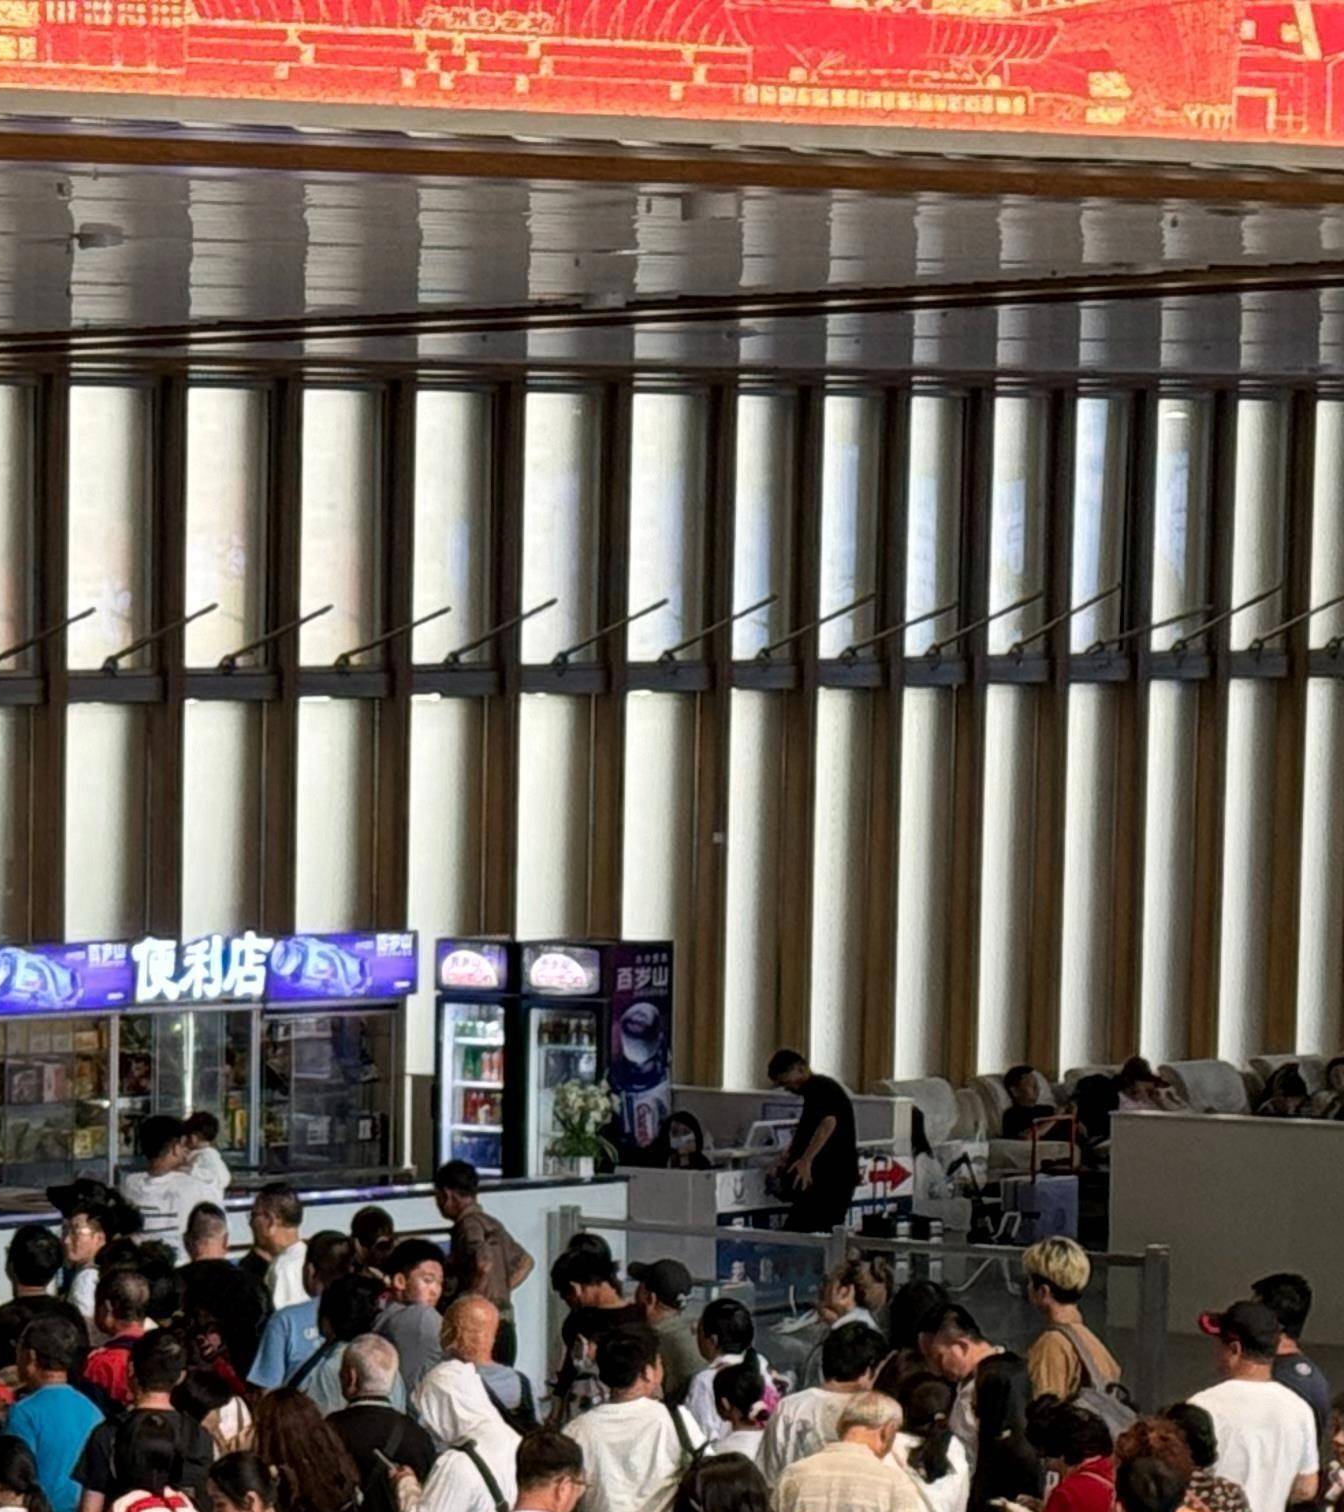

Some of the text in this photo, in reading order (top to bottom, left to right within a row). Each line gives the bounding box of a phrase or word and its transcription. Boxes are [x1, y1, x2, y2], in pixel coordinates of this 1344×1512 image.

[132, 931, 274, 1003] 便利店
[617, 965, 668, 991] 百岁山
